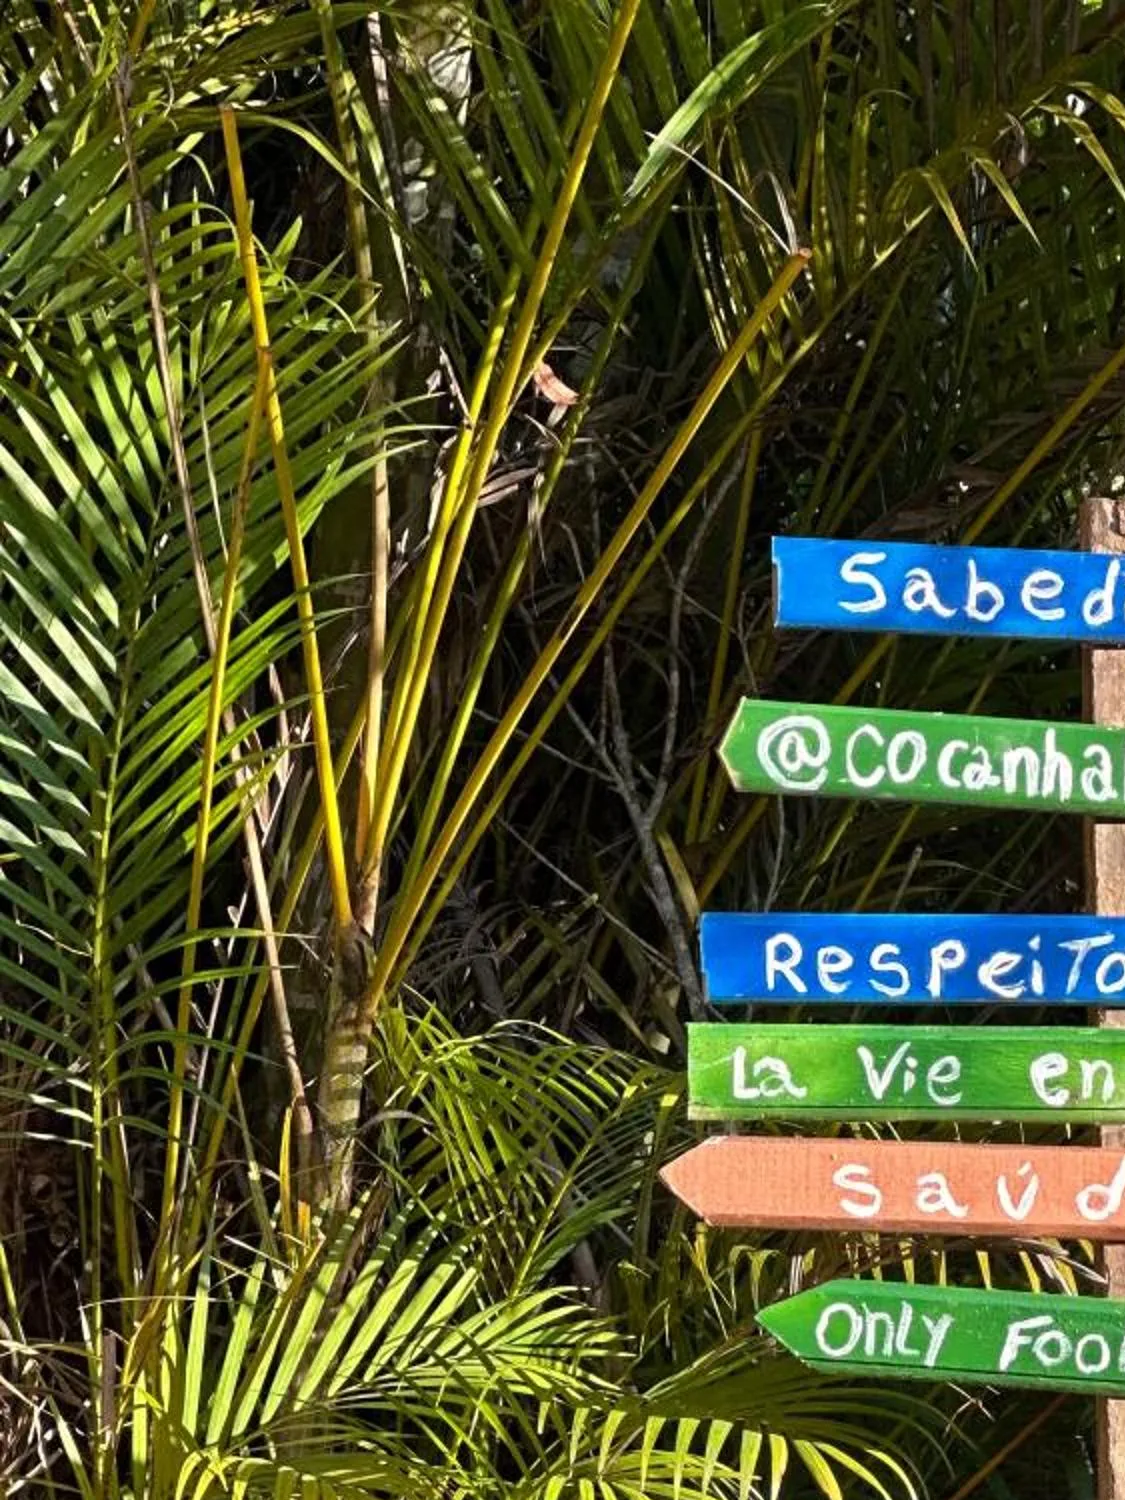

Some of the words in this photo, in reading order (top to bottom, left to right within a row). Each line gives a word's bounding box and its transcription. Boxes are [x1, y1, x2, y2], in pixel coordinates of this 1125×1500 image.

[732, 1046, 807, 1099] La
[857, 1041, 961, 1106] Vie
[1029, 1052, 1115, 1106] en
